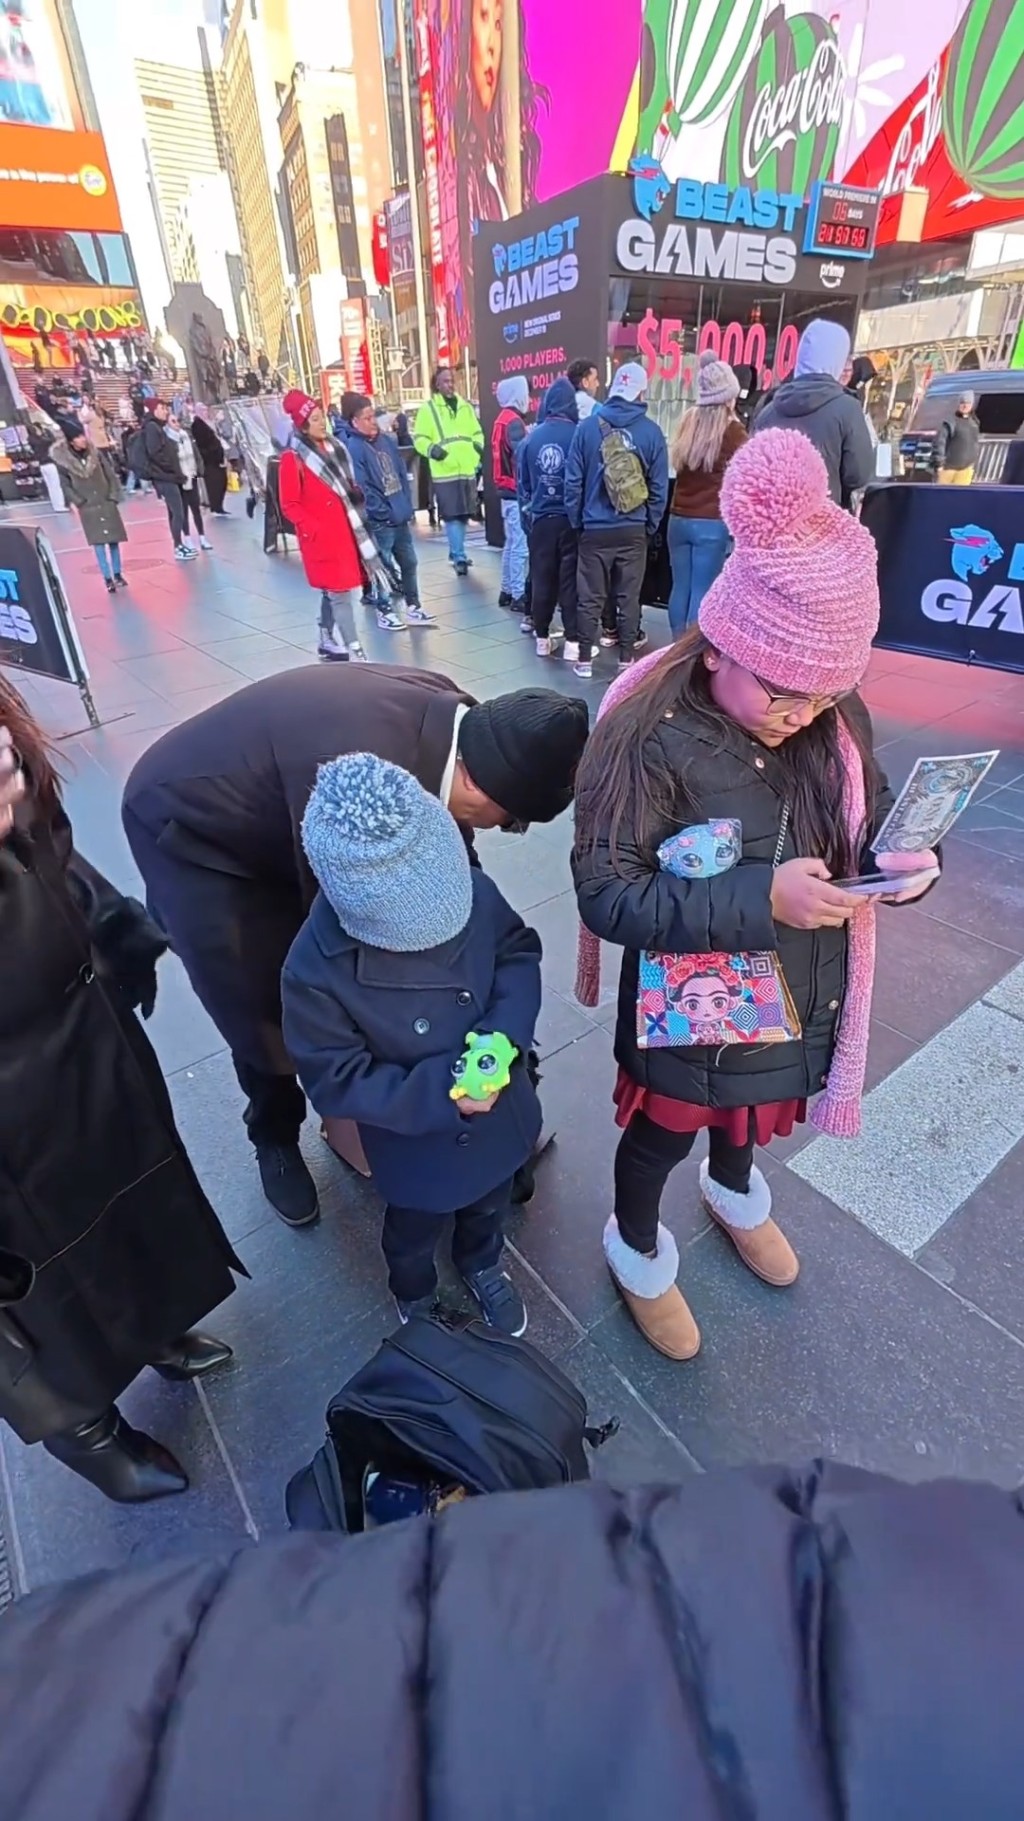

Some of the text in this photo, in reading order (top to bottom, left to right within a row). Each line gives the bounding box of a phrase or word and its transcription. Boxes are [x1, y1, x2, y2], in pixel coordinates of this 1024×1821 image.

[675, 178, 803, 232] BEAST
[823, 187, 844, 199] WORLD
[507, 216, 580, 273] BEAST
[616, 218, 797, 284] GAMES
[819, 260, 845, 279] prime
[489, 253, 580, 314] GAMES
[500, 347, 567, 374] 1,000 PLAYERS.
